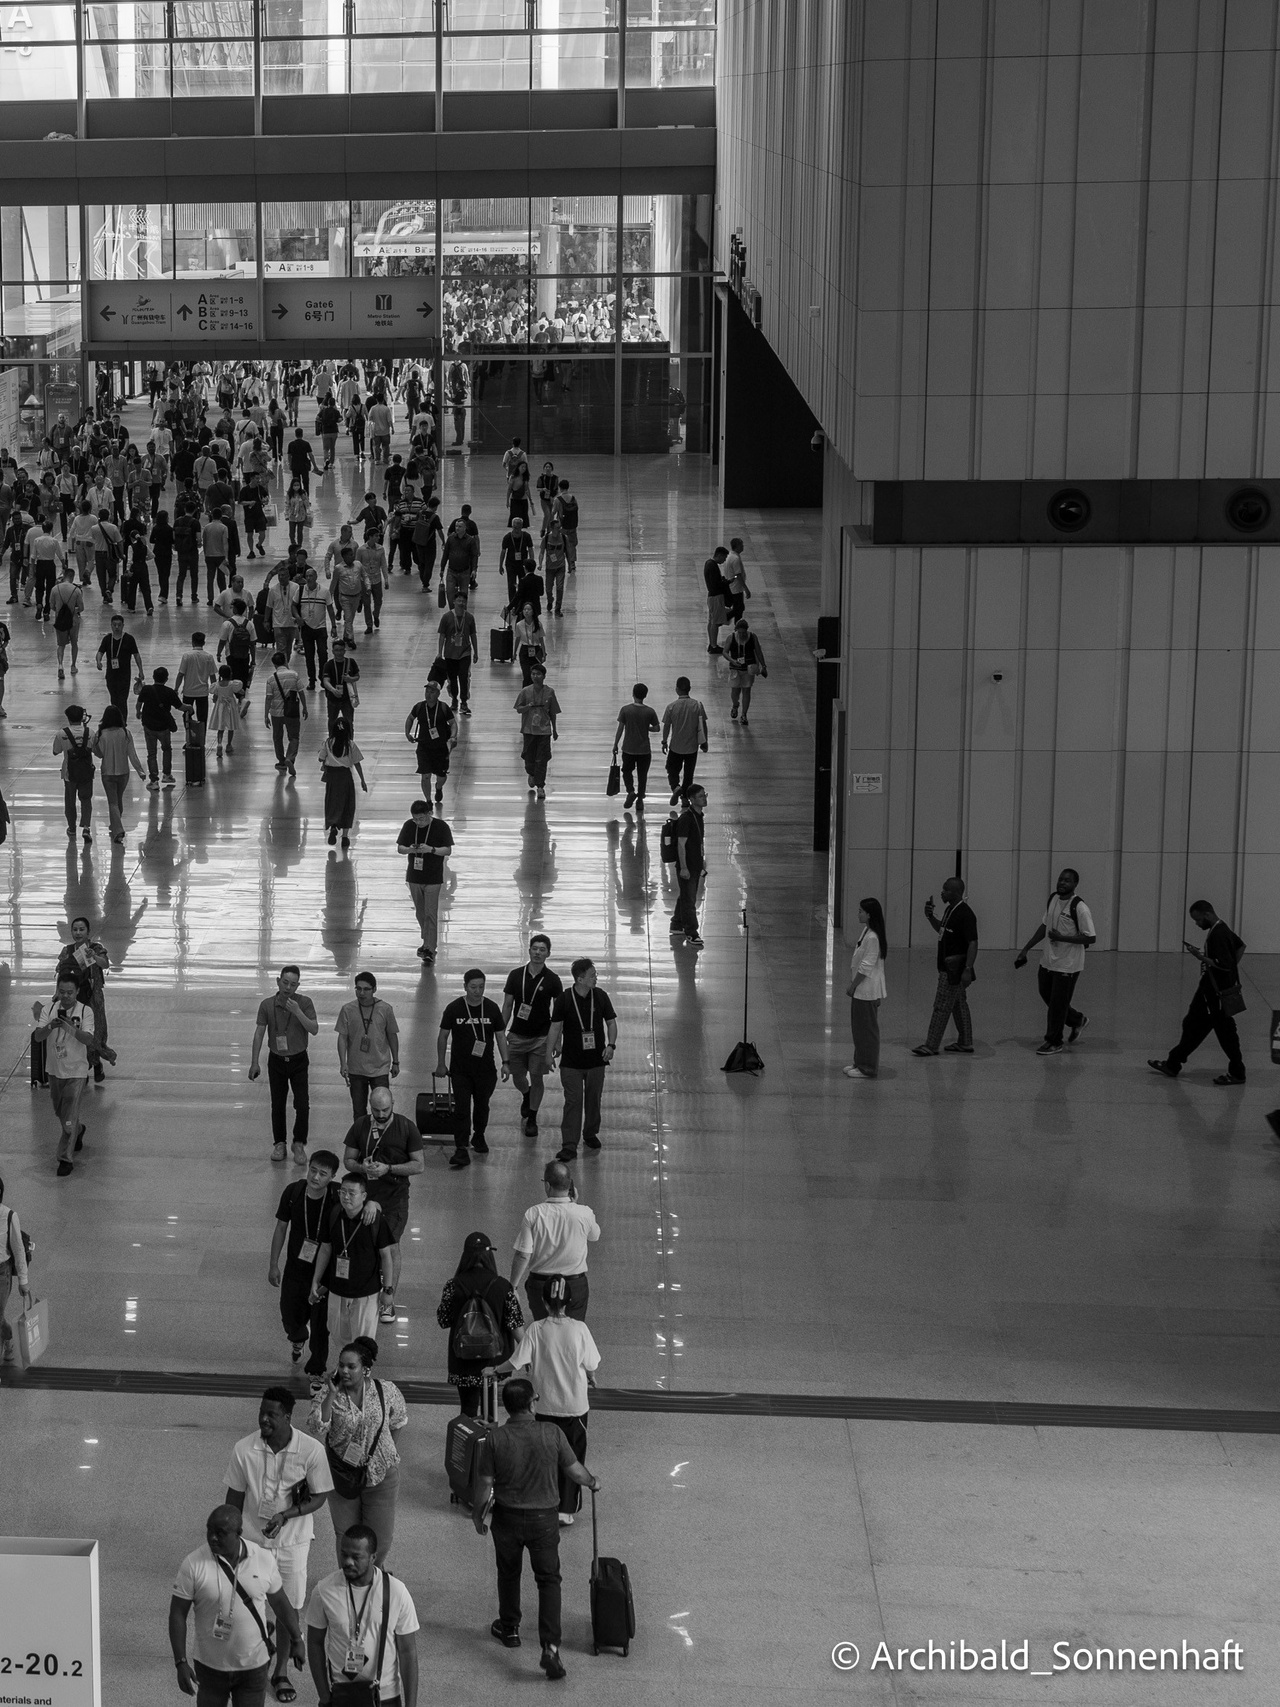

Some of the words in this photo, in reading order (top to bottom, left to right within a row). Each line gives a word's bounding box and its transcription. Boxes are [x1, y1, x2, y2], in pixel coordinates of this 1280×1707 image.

[7, 6, 34, 30] A
[453, 245, 460, 253] C
[278, 263, 286, 272] A
[197, 293, 208, 305] A
[229, 296, 244, 304] 1-8
[305, 300, 334, 309] Gate6
[198, 306, 208, 317] B
[229, 309, 248, 317] 9-13
[304, 310, 335, 322] 6号门
[198, 319, 208, 331] C
[229, 322, 253, 330] 14-16
[33, 1697, 52, 1706] and
